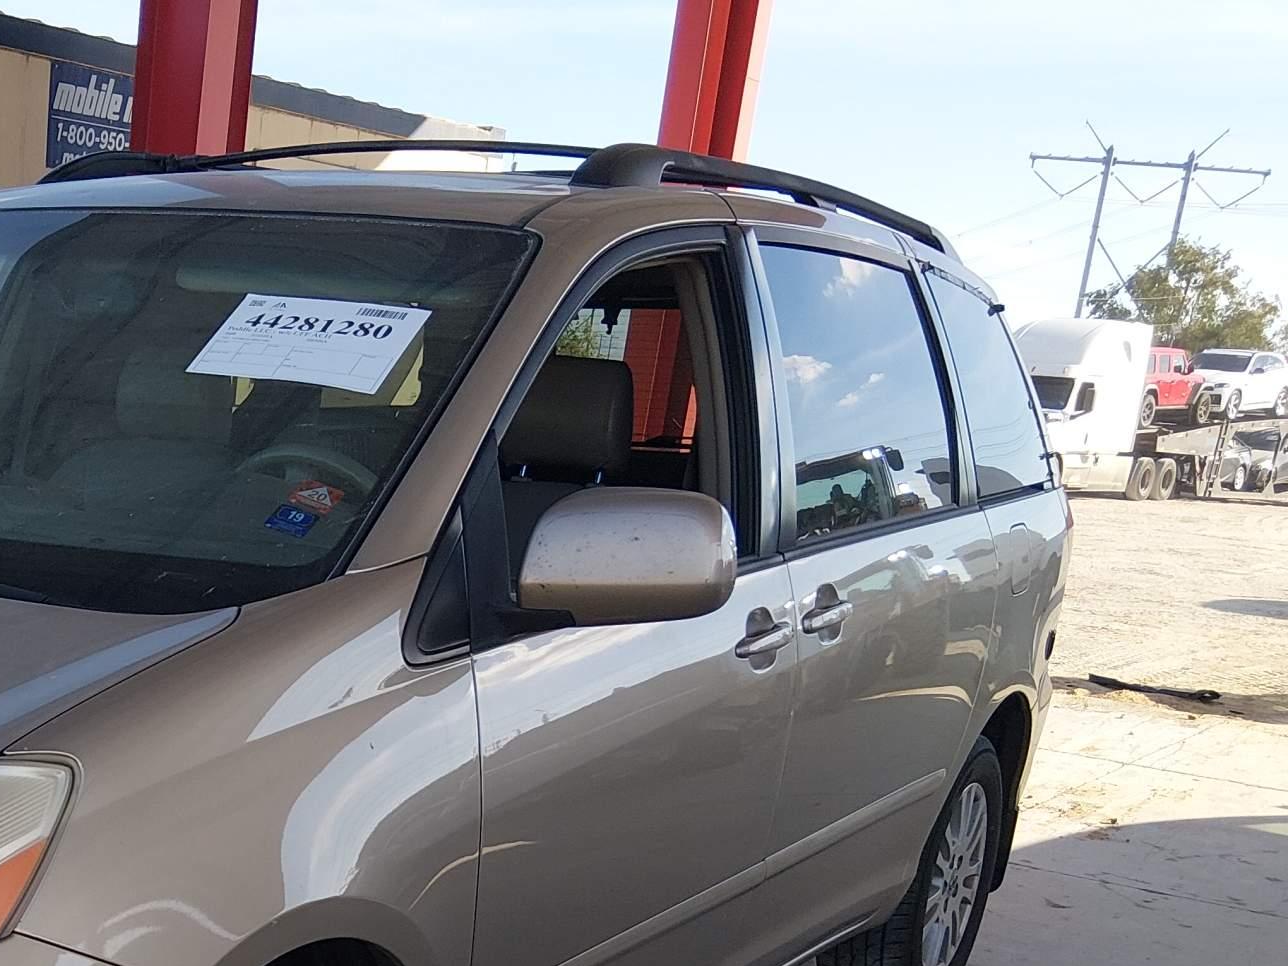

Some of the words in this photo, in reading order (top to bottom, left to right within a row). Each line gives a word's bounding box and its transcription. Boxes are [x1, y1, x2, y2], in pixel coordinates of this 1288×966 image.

[52, 74, 123, 121] mobile
[245, 313, 393, 340] 44281280
[307, 490, 327, 501] 20
[287, 511, 305, 522] 19
